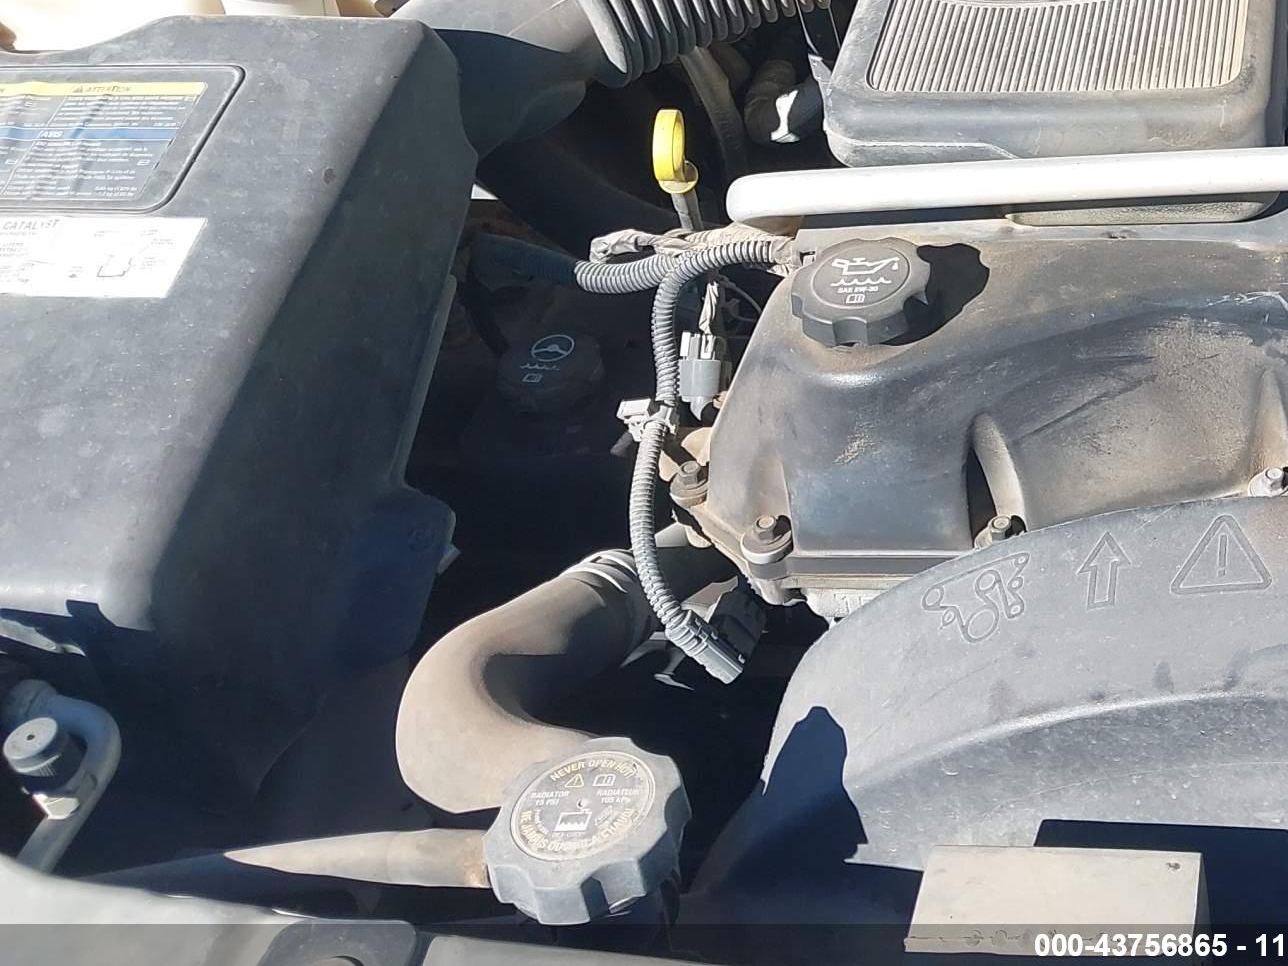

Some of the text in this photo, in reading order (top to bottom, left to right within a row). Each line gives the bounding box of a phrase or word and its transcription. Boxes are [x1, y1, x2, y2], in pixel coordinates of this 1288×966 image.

[550, 761, 585, 782] NEVER
[588, 759, 616, 769] OPEN
[529, 790, 571, 800] RADIATOR
